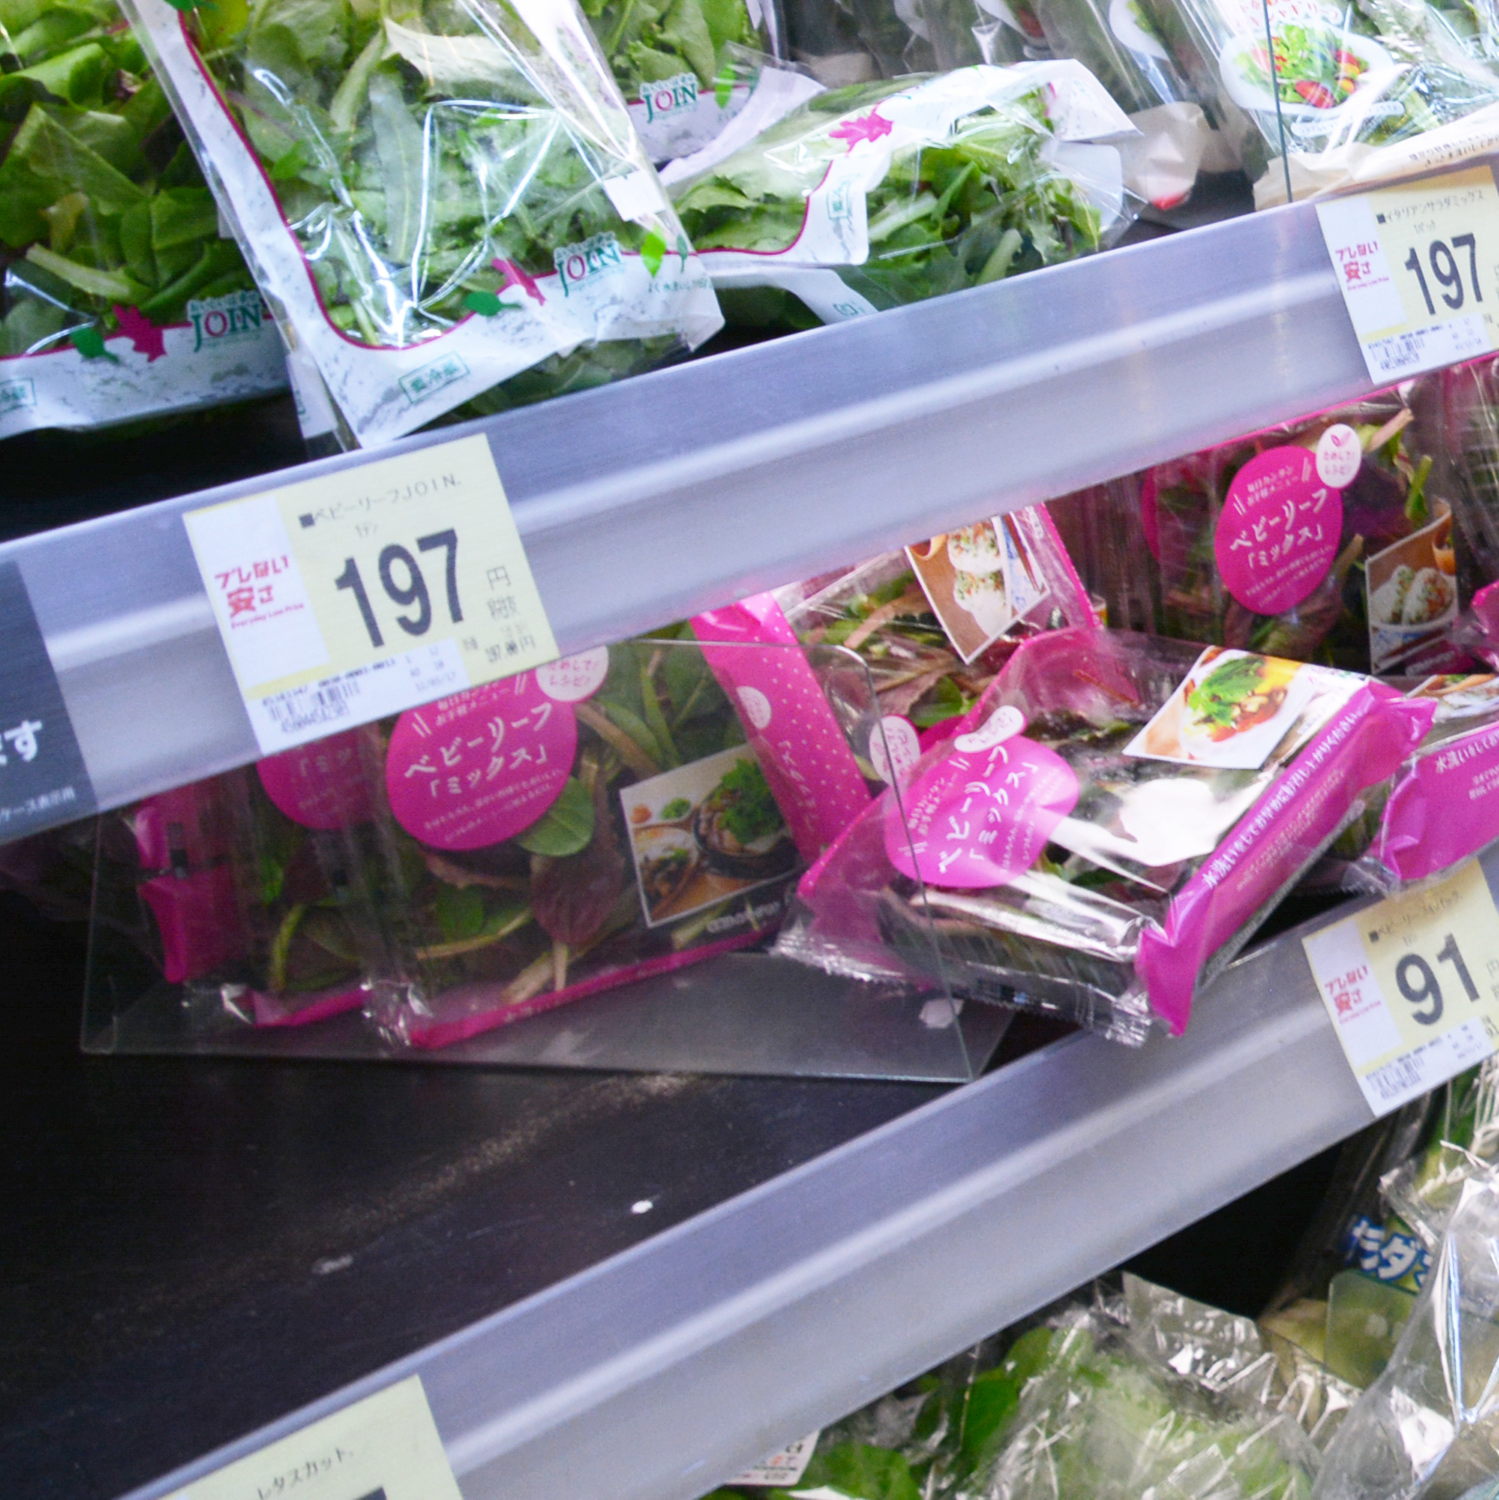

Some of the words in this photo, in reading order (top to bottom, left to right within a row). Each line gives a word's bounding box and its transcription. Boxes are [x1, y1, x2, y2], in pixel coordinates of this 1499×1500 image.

[642, 82, 698, 124] JOIN
[558, 242, 622, 298] JOIN
[1343, 261, 1372, 283] 安さ
[1404, 232, 1483, 316] 197
[190, 303, 262, 353] JOIN
[1229, 487, 1328, 552] ベビーリーフ
[1247, 523, 1324, 570] 「ミックス」
[214, 554, 290, 591] ブレない
[225, 583, 275, 617] 安さ
[334, 527, 465, 649] 197
[485, 565, 512, 591] 円
[403, 701, 553, 780] ベビーリーフ
[430, 743, 548, 799] 「ミックス」
[938, 745, 1010, 875] ベビーリーフ
[1395, 932, 1481, 1027] 91
